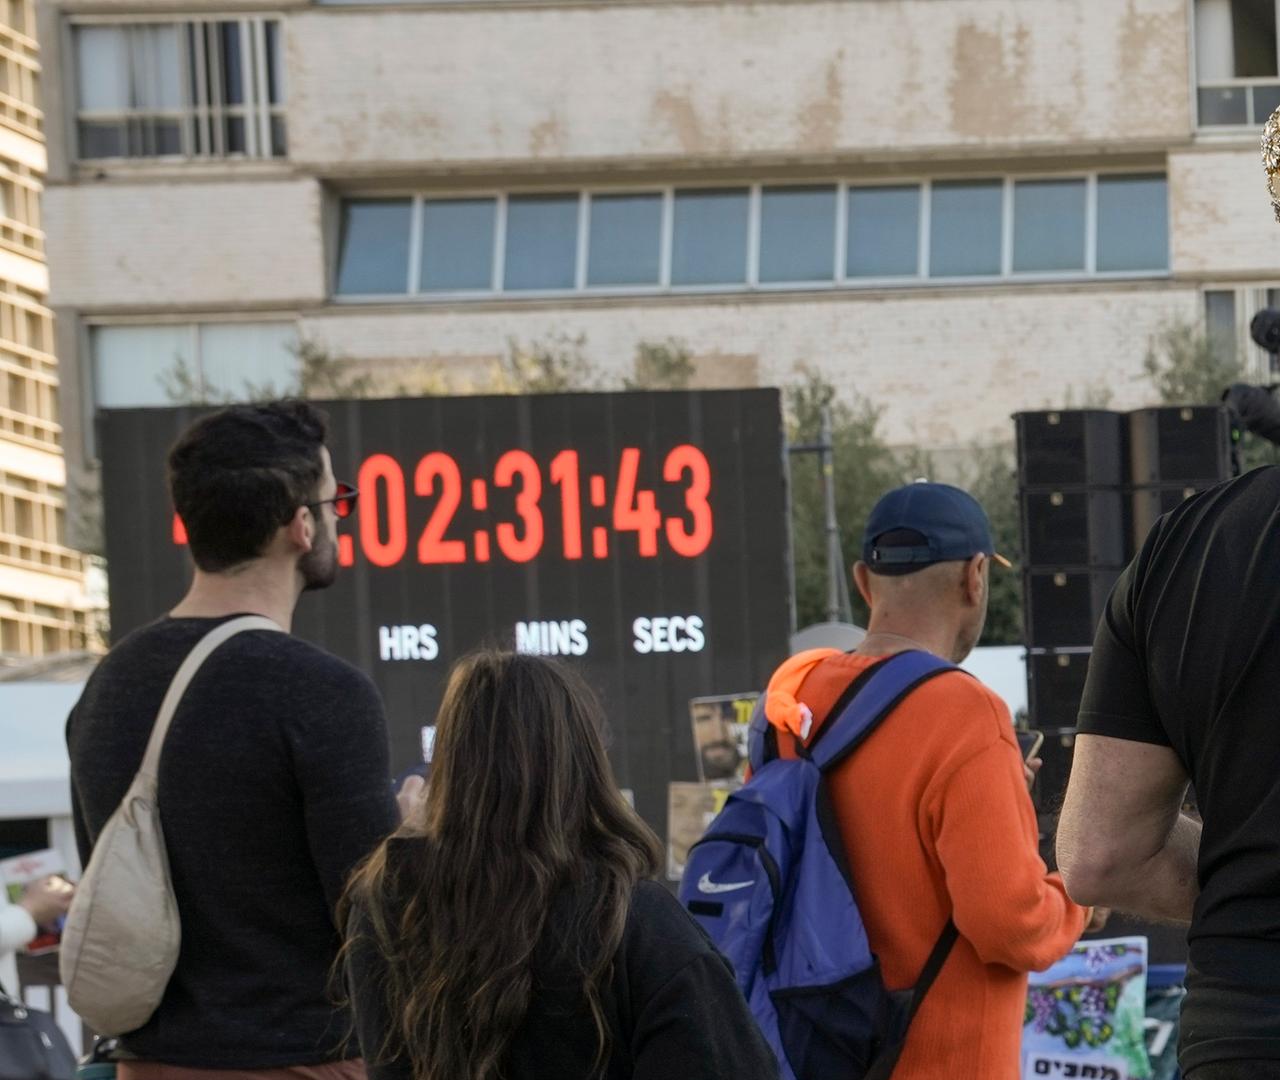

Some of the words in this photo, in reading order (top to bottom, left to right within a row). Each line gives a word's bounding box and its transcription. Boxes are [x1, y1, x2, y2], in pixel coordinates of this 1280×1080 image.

[379, 624, 439, 661] HRS
[515, 619, 588, 657] MINS
[633, 615, 705, 654] SECS
